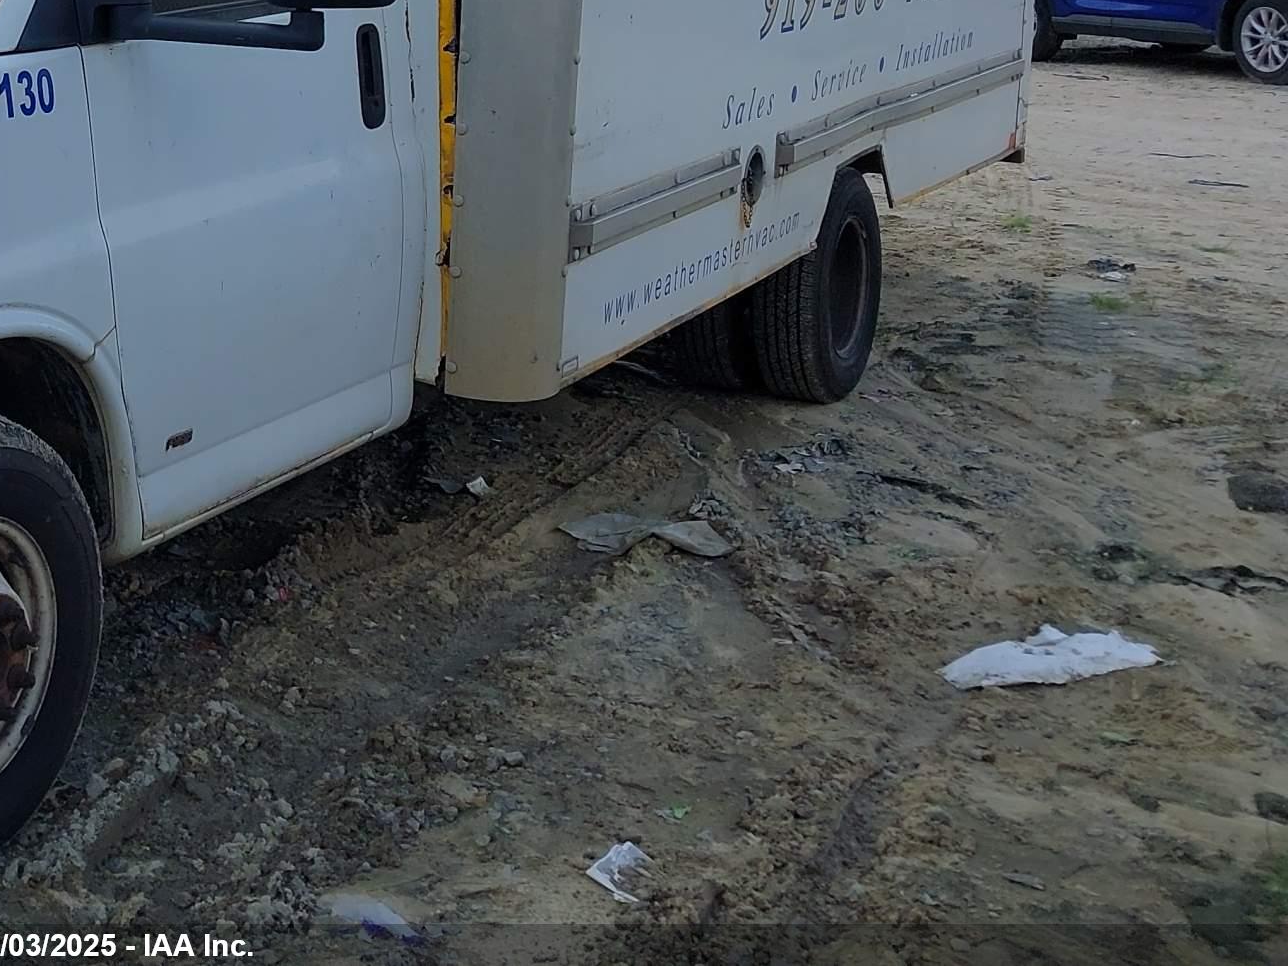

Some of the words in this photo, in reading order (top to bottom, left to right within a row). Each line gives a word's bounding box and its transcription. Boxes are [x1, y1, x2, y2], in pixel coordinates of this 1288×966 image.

[721, 86, 775, 130] Sales
[811, 59, 868, 102] Service
[895, 28, 974, 72] Installation
[603, 210, 801, 325] www.weathermasterhvac.com
